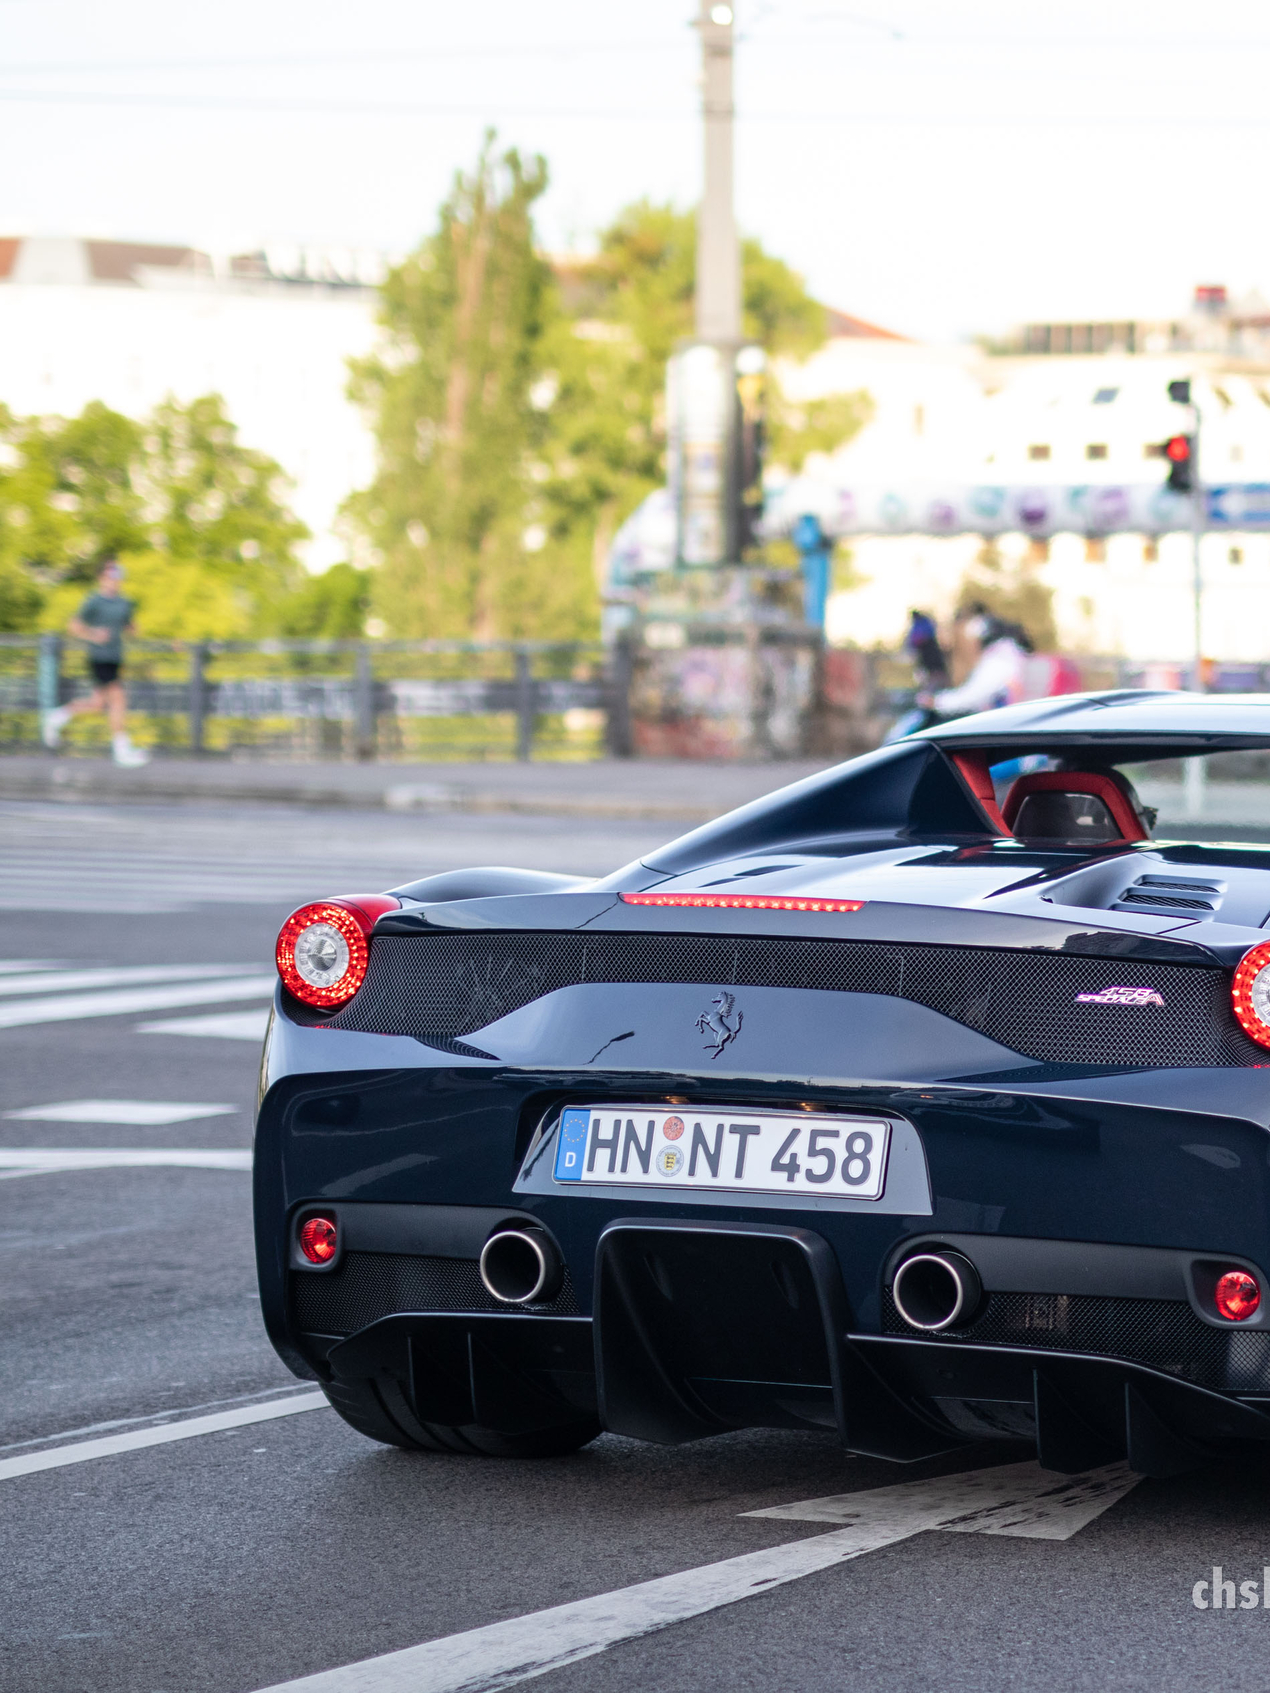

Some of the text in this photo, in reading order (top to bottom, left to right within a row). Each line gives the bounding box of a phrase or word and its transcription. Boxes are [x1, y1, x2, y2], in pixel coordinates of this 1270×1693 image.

[1100, 986, 1153, 998] 458
[564, 1151, 577, 1168] D
[587, 1119, 656, 1174] HN
[688, 1122, 760, 1179] NT
[770, 1128, 873, 1186] 458
